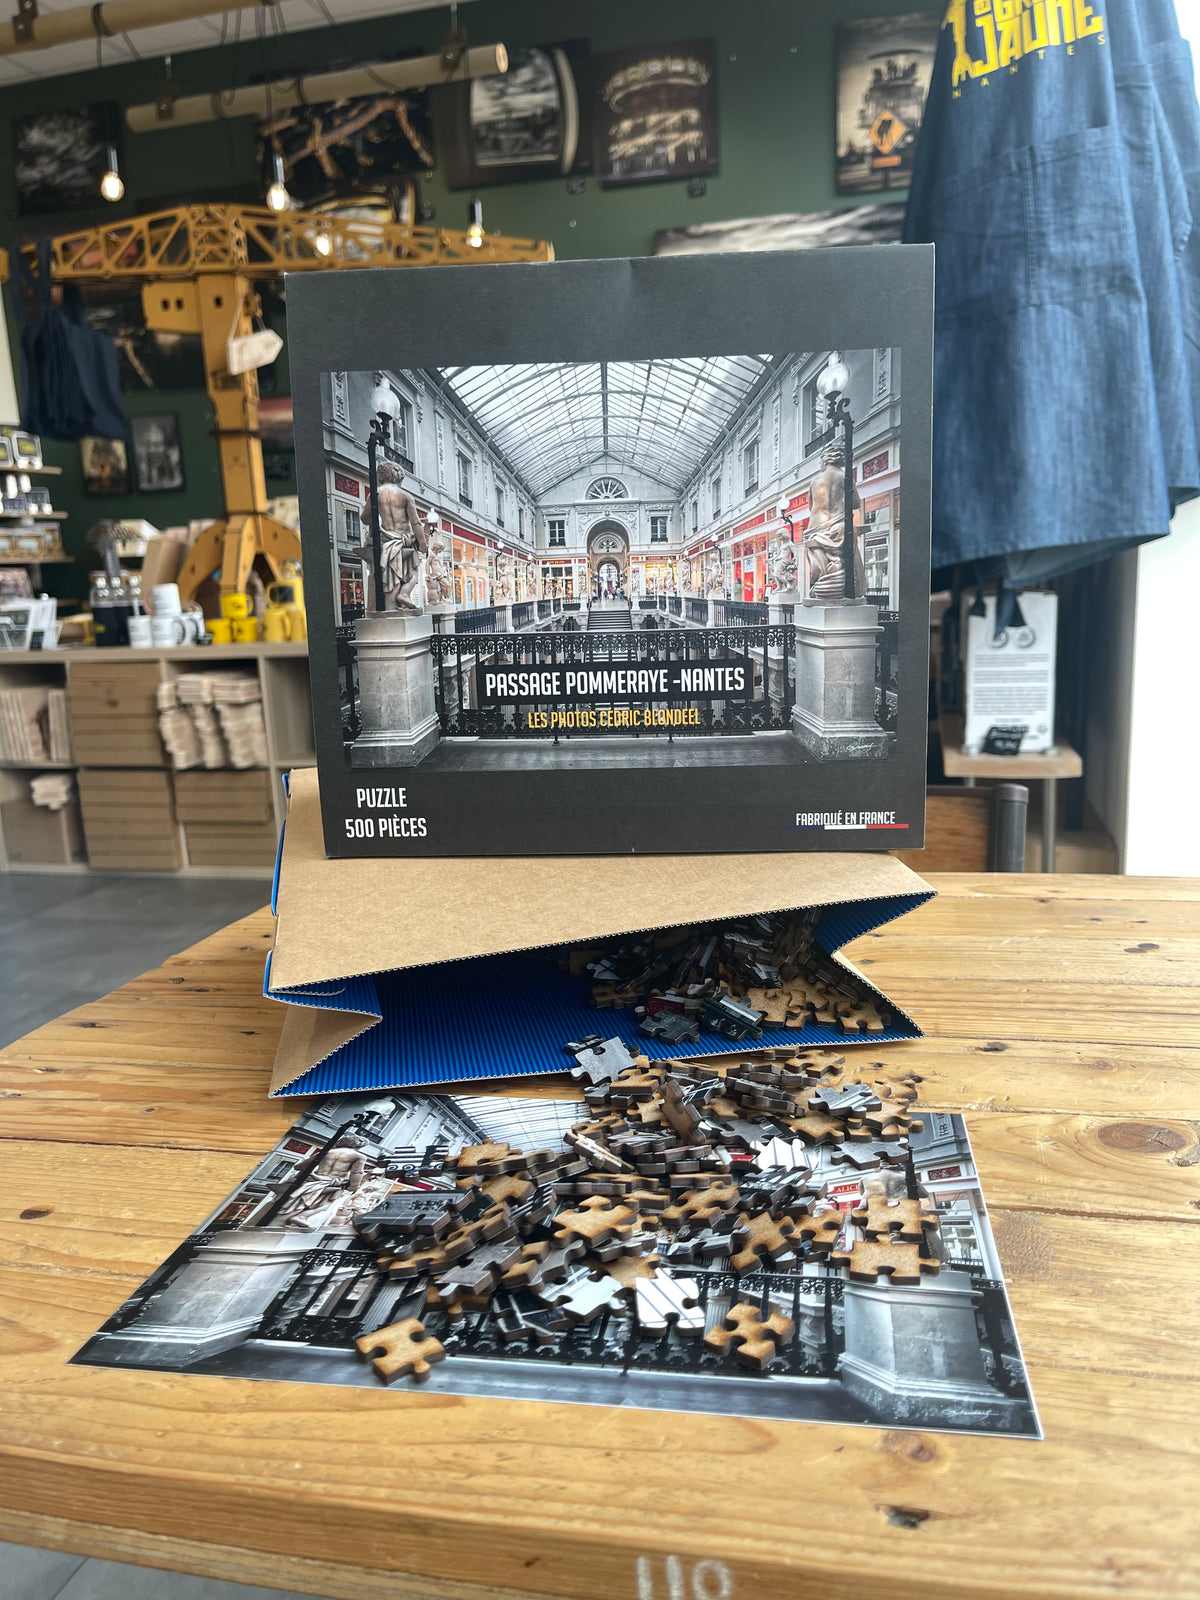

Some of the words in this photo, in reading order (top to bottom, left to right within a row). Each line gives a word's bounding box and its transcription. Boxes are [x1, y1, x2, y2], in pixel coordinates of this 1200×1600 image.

[973, 0, 1104, 78] JAUNE
[952, 34, 1106, 99] NANTES
[485, 671, 561, 697] PASSAGE
[566, 669, 668, 695] POMMERAYE
[673, 667, 745, 692] -NANTES
[528, 712, 547, 729] LES
[551, 711, 597, 728] PHOTOS
[600, 707, 641, 727] CÉDRIC
[644, 708, 701, 726] BLONDEEL
[356, 787, 408, 808] PUZZLE
[345, 818, 375, 838] 500
[378, 813, 428, 838] PIÈCES
[796, 809, 842, 826] FABRIQUÉ
[845, 812, 857, 825] EN
[859, 811, 896, 825] FRANCE
